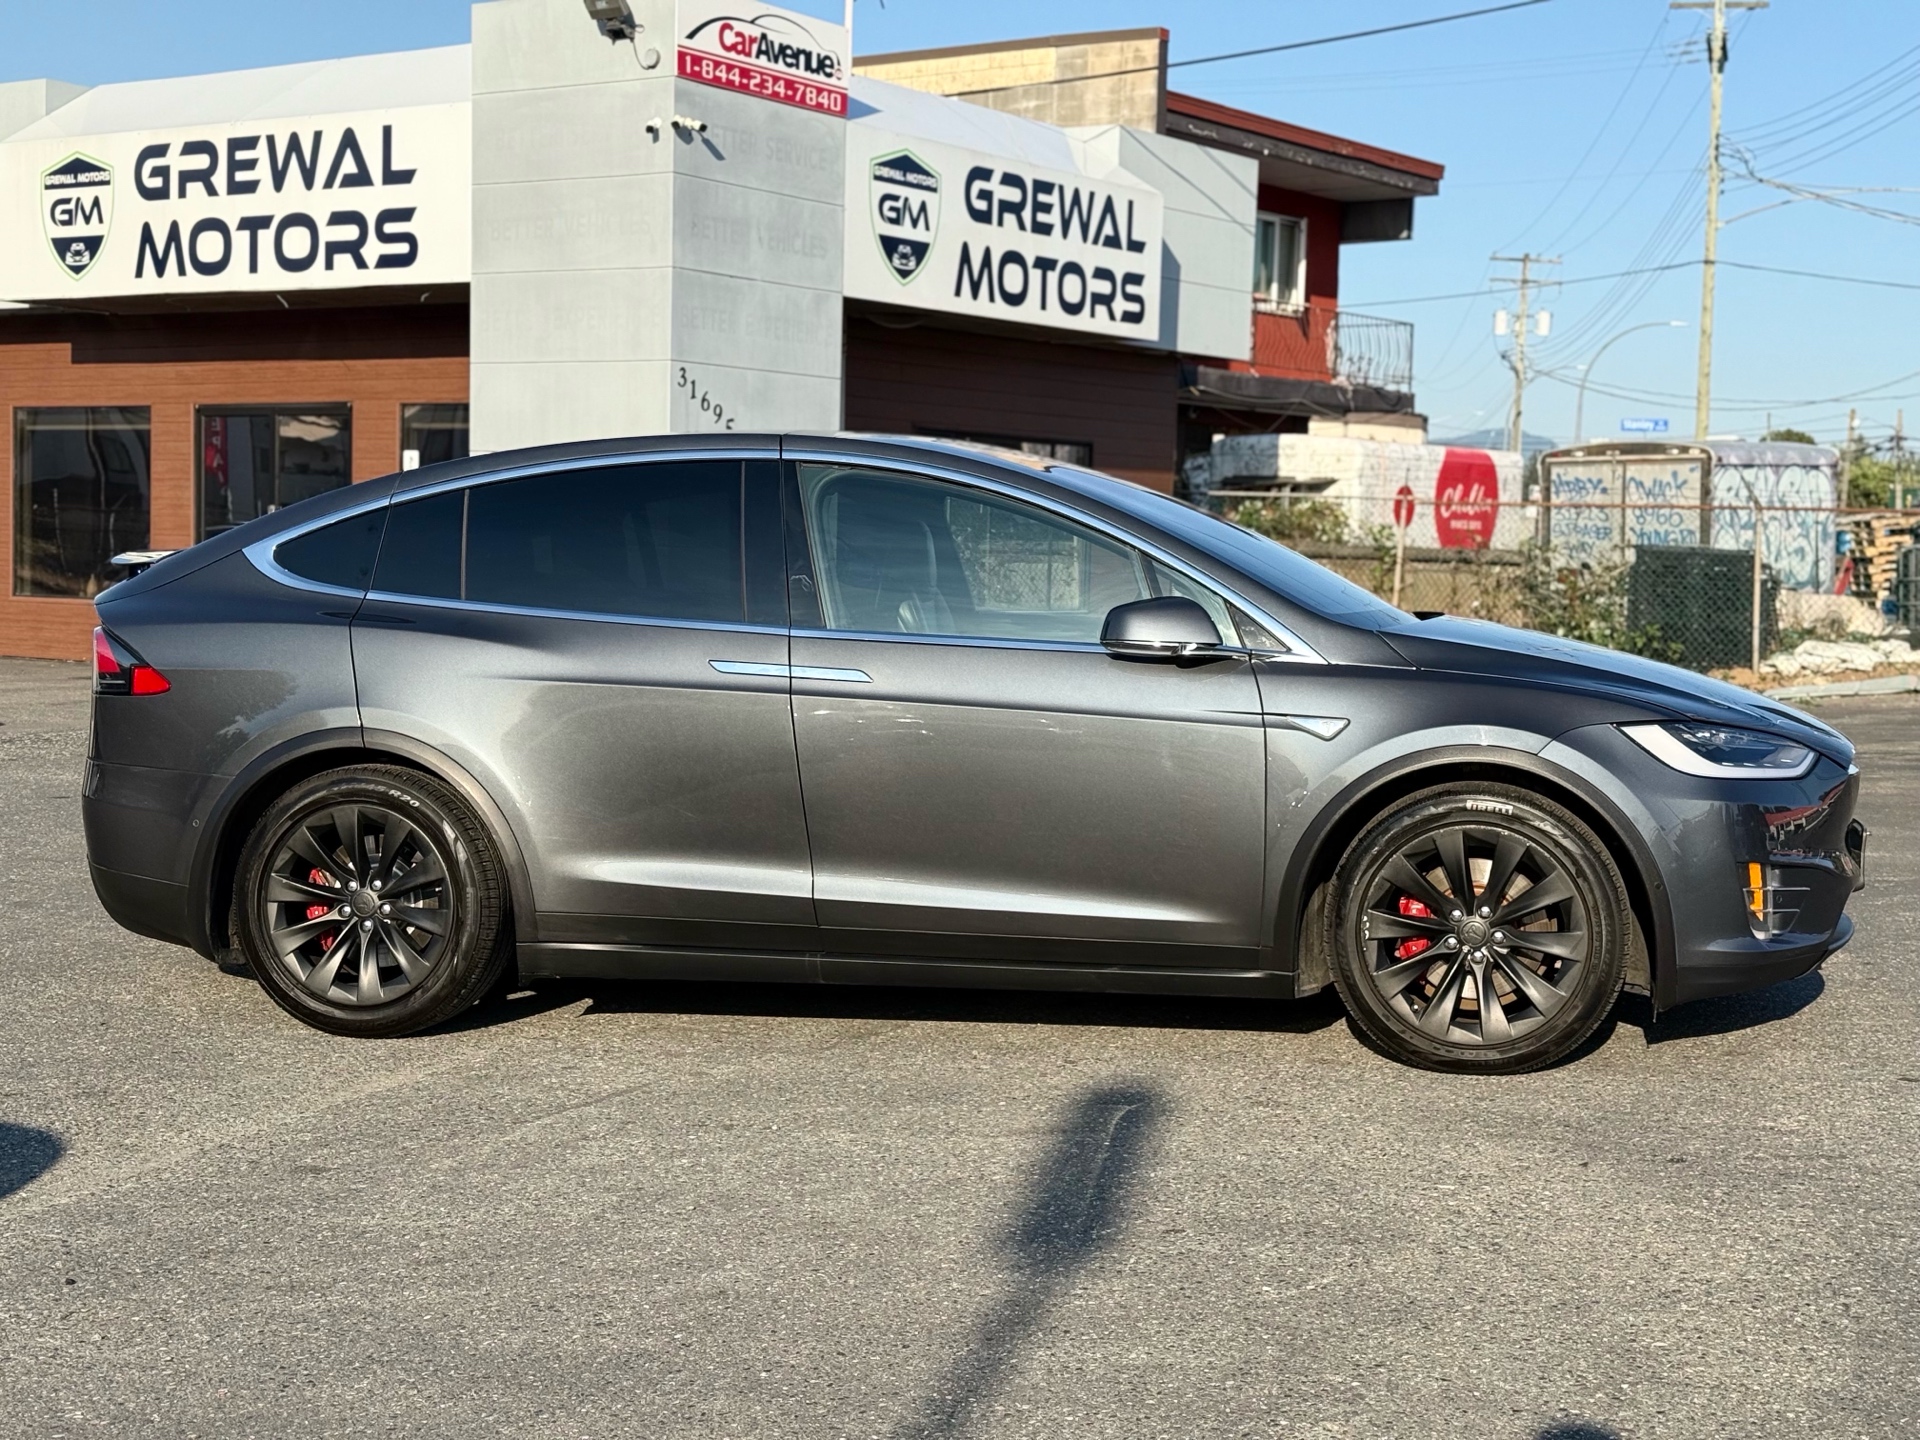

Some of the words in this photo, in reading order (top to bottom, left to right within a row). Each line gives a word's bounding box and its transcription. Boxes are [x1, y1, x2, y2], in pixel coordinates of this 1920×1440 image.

[718, 22, 835, 79] CarAvenue
[685, 54, 842, 112] 1-844-234-7840
[45, 173, 77, 186] GREWAL
[77, 170, 111, 184] MOTORS
[134, 124, 418, 202] GREWAL
[50, 195, 104, 228] GM
[878, 193, 930, 232] GM
[964, 165, 1147, 254] GREWAL
[134, 206, 419, 279] MOTORS
[954, 241, 1146, 325] MOTORS
